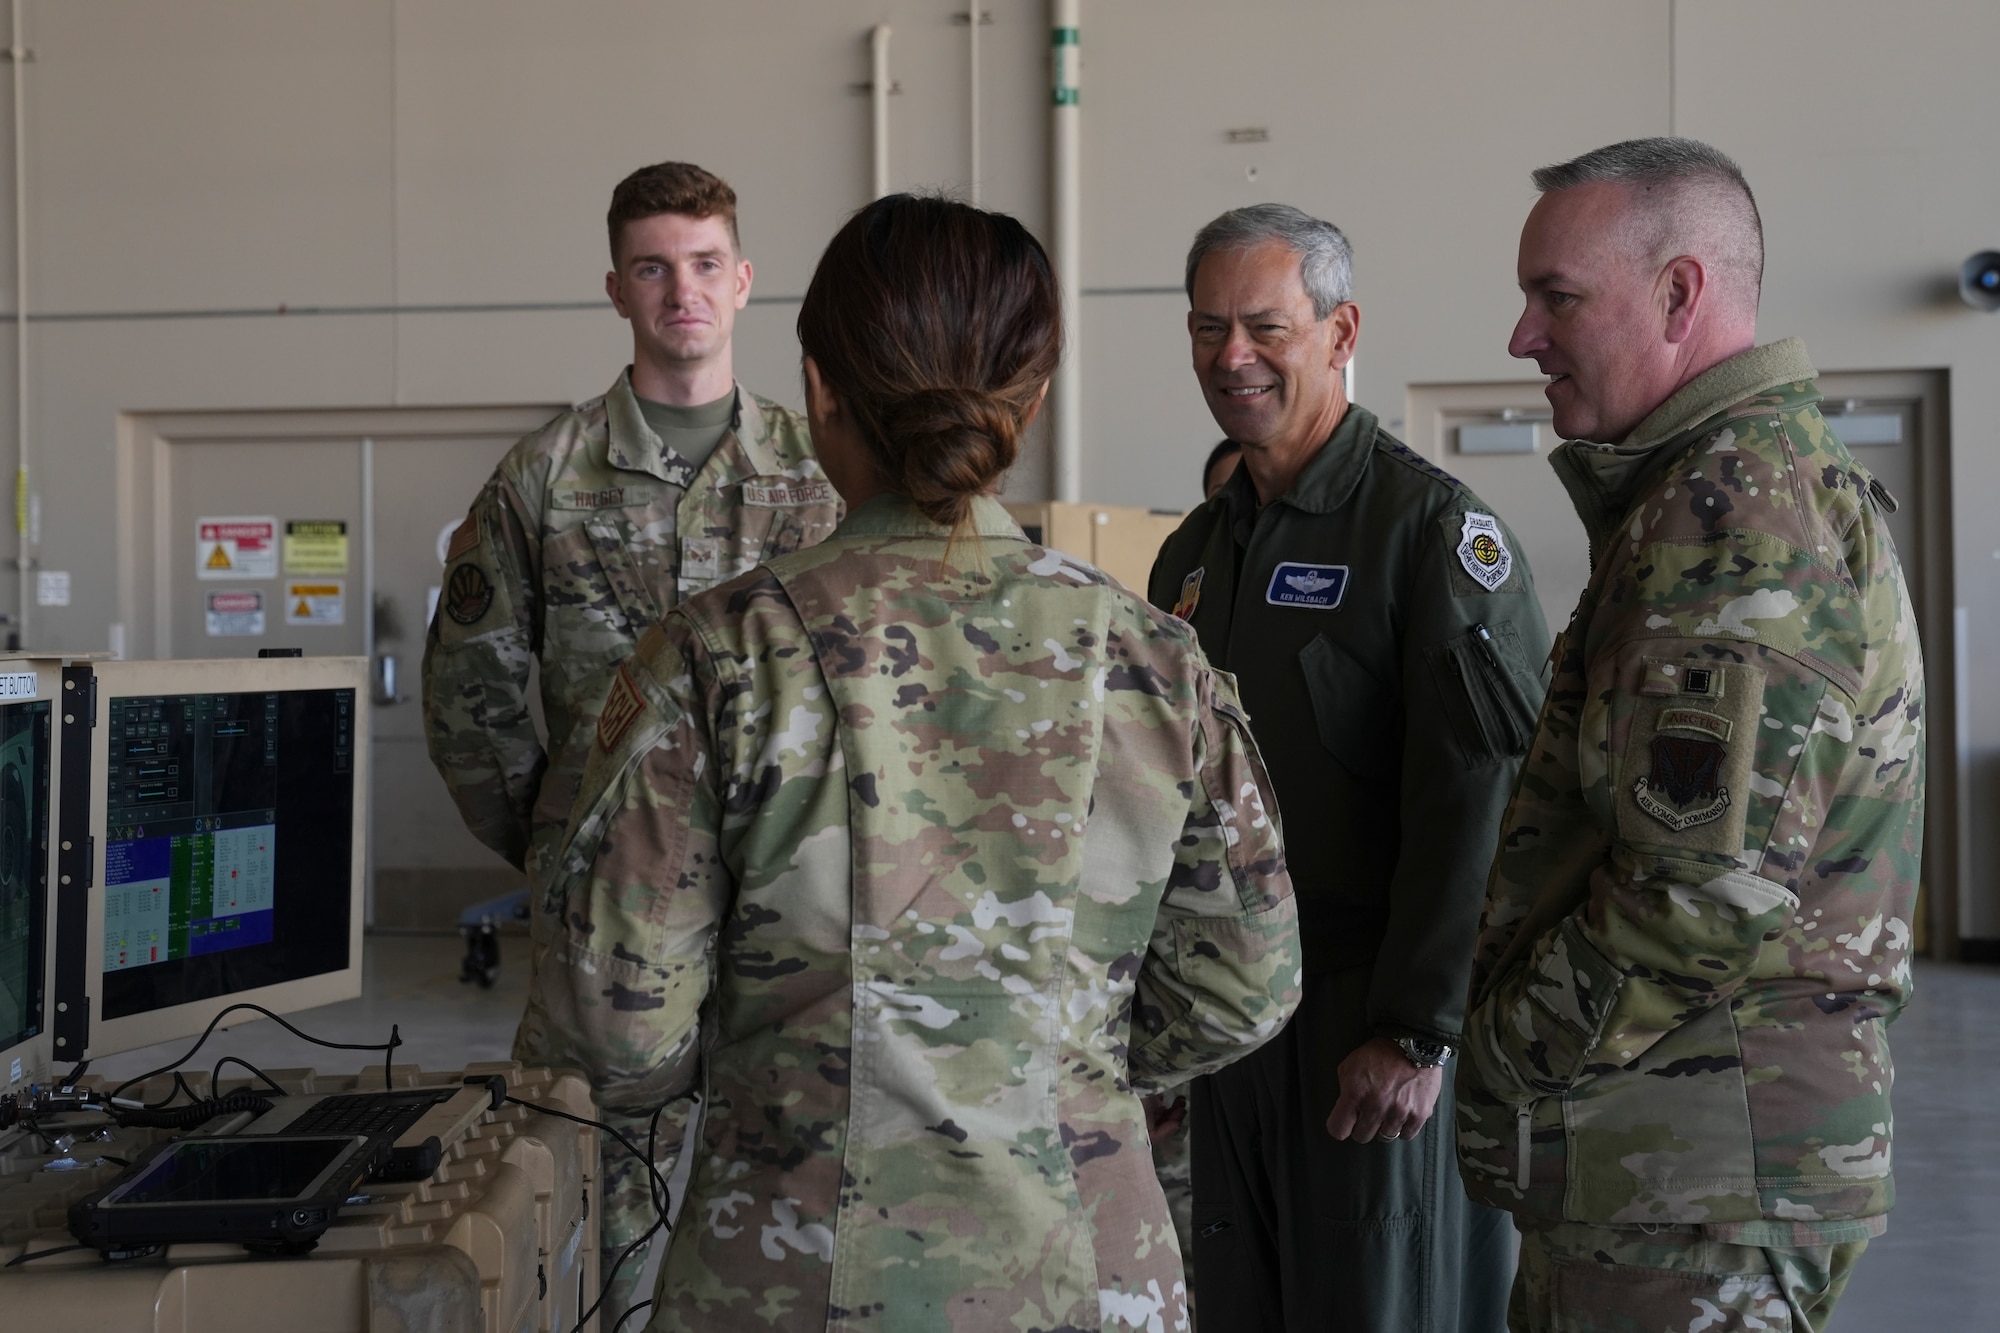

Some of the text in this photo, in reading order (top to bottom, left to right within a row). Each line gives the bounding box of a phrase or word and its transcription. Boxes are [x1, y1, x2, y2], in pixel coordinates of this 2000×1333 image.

[574, 488, 625, 508] HALSEY
[768, 488, 787, 504] AIR
[788, 485, 829, 503] FORCE
[1469, 517, 1493, 528] GRADUATE
[1470, 561, 1488, 579] FIGHTER
[1280, 592, 1328, 605] KEN WILSBACH
[10, 675, 36, 695] BUTTON
[1669, 712, 1720, 731] ARCTIC
[1640, 796, 1724, 829] AIR COMBAT COMMAND
